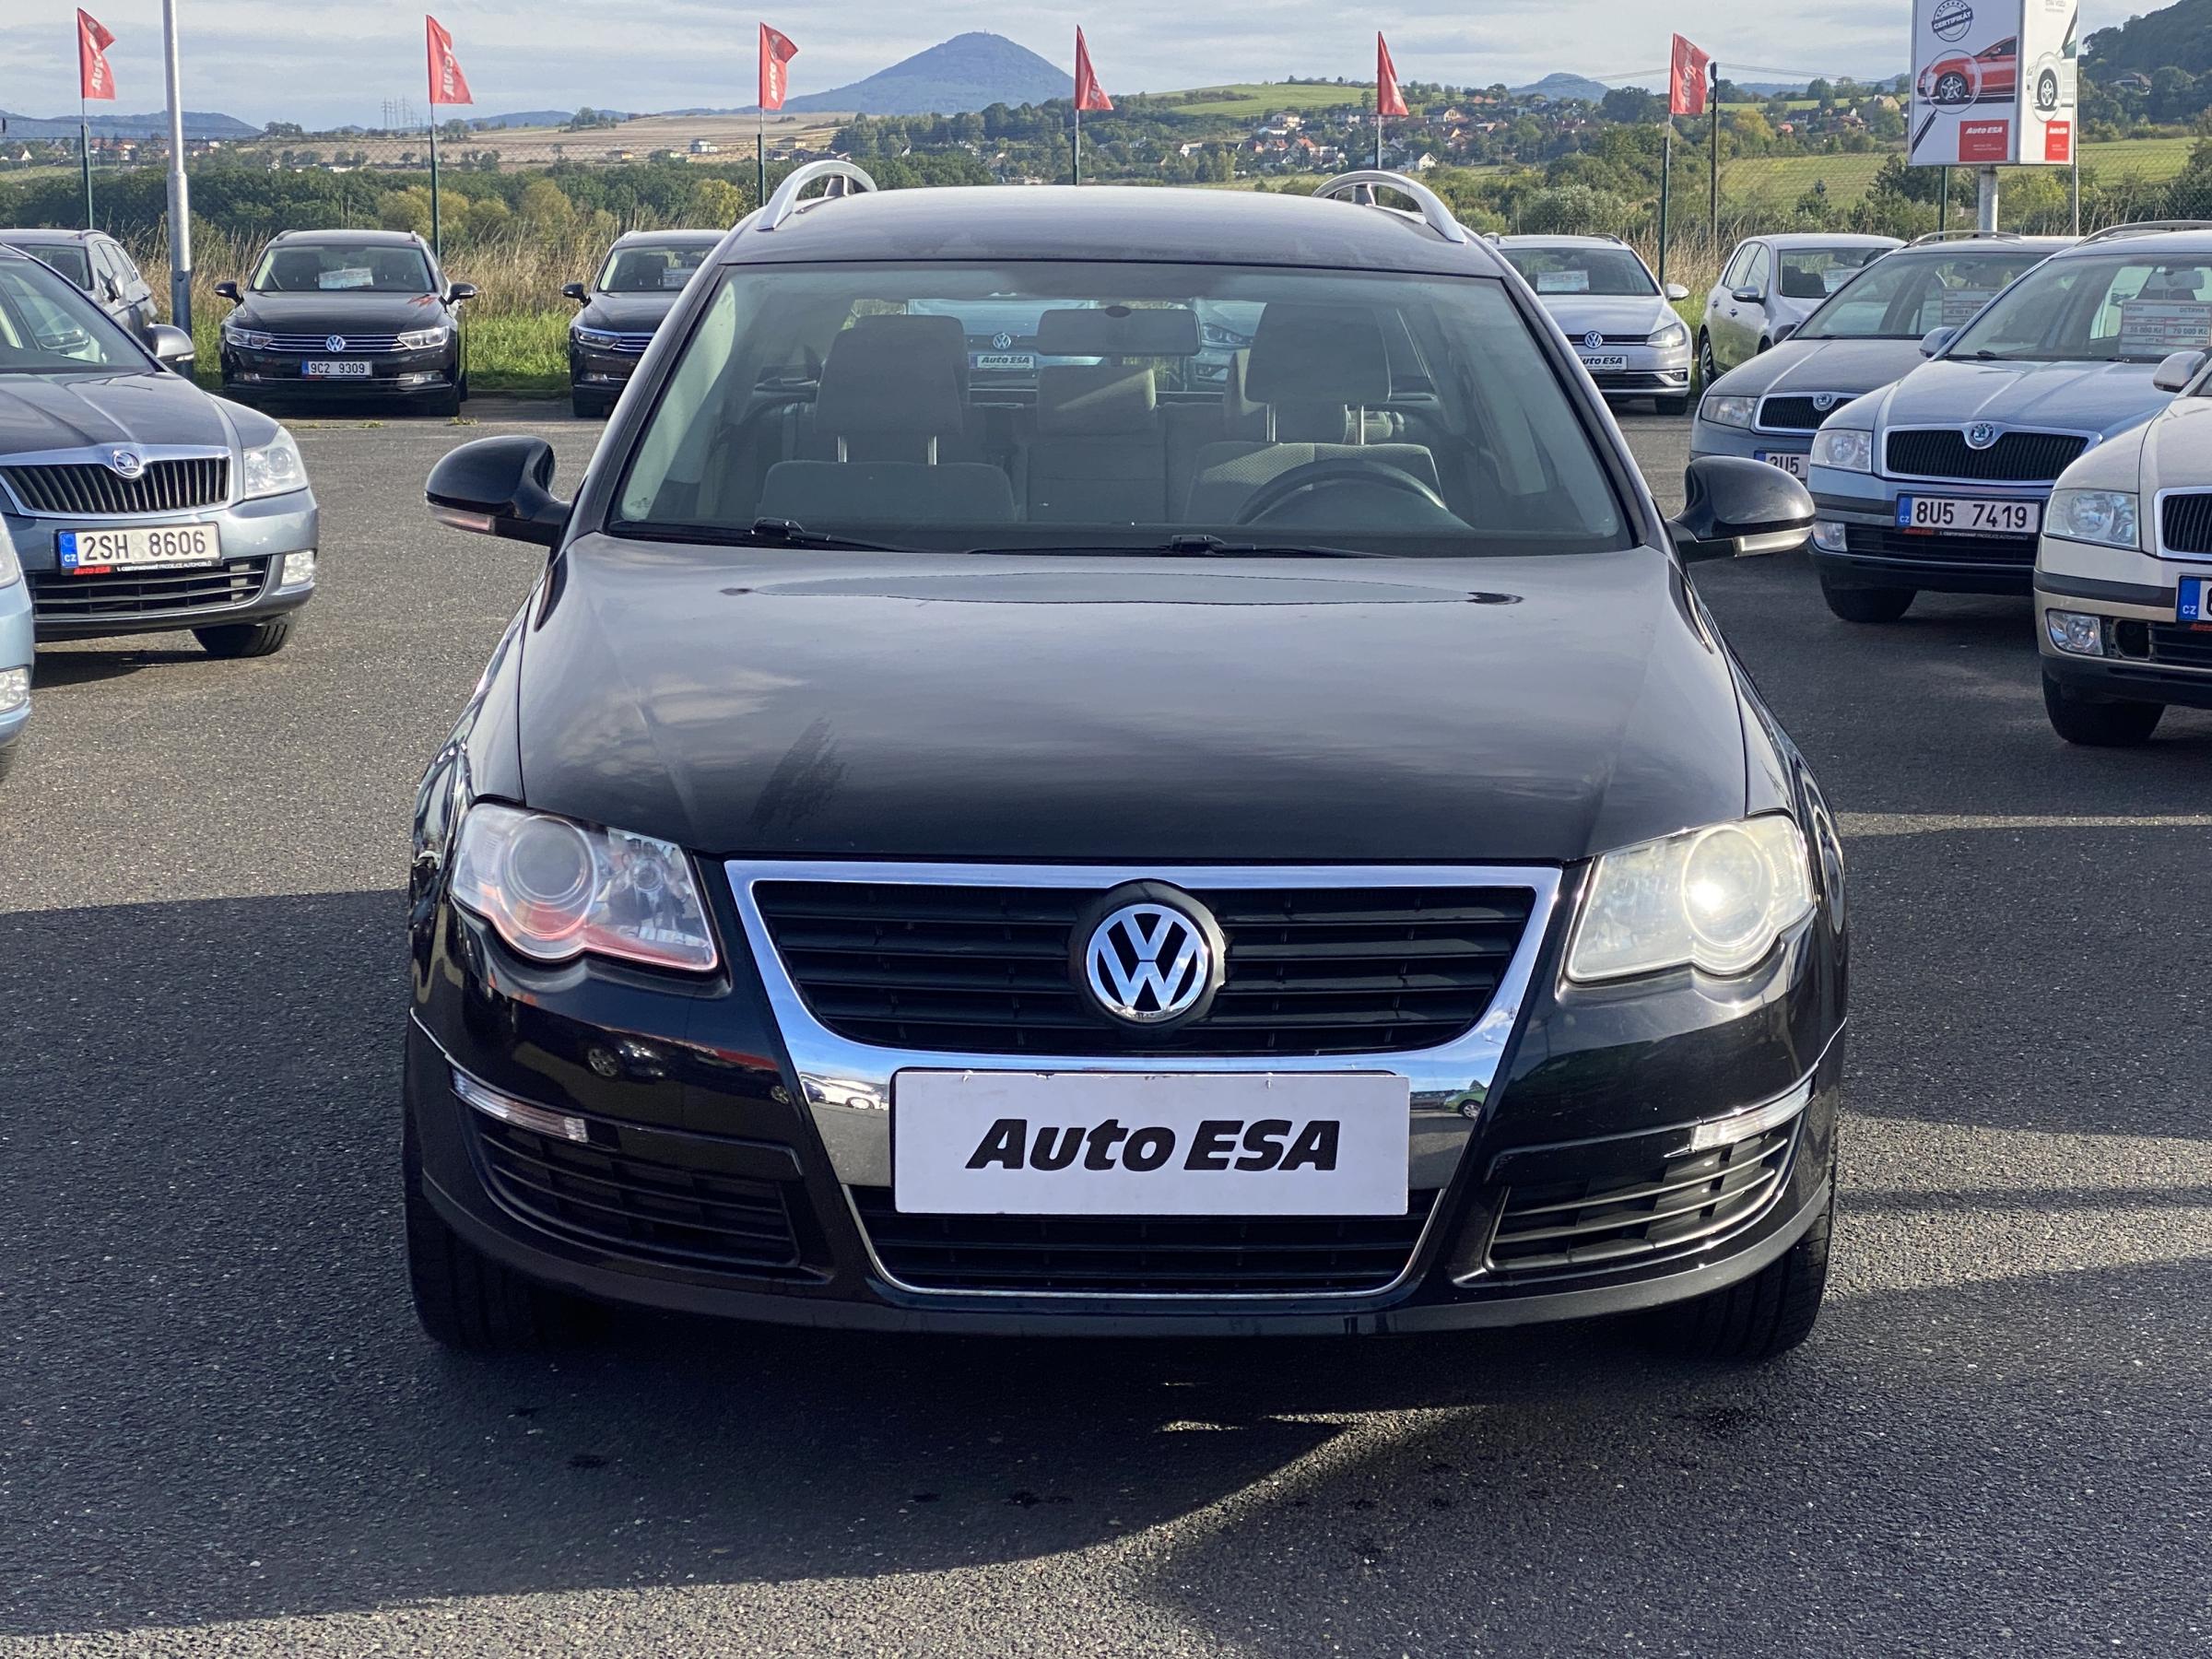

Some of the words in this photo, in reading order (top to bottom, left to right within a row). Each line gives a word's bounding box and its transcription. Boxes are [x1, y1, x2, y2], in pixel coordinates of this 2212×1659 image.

[311, 363, 330, 373] 9C2
[338, 363, 365, 373] 9309
[1603, 357, 1622, 365] ESA
[1916, 501, 1955, 524] 8U5
[1972, 504, 2027, 528] 7419
[65, 554, 76, 562] CZ
[83, 535, 129, 561] 2SH
[149, 530, 206, 557] 8606
[2183, 605, 2197, 615] CZ
[965, 1118, 1176, 1171] Auto
[1183, 1120, 1340, 1171] ESA
